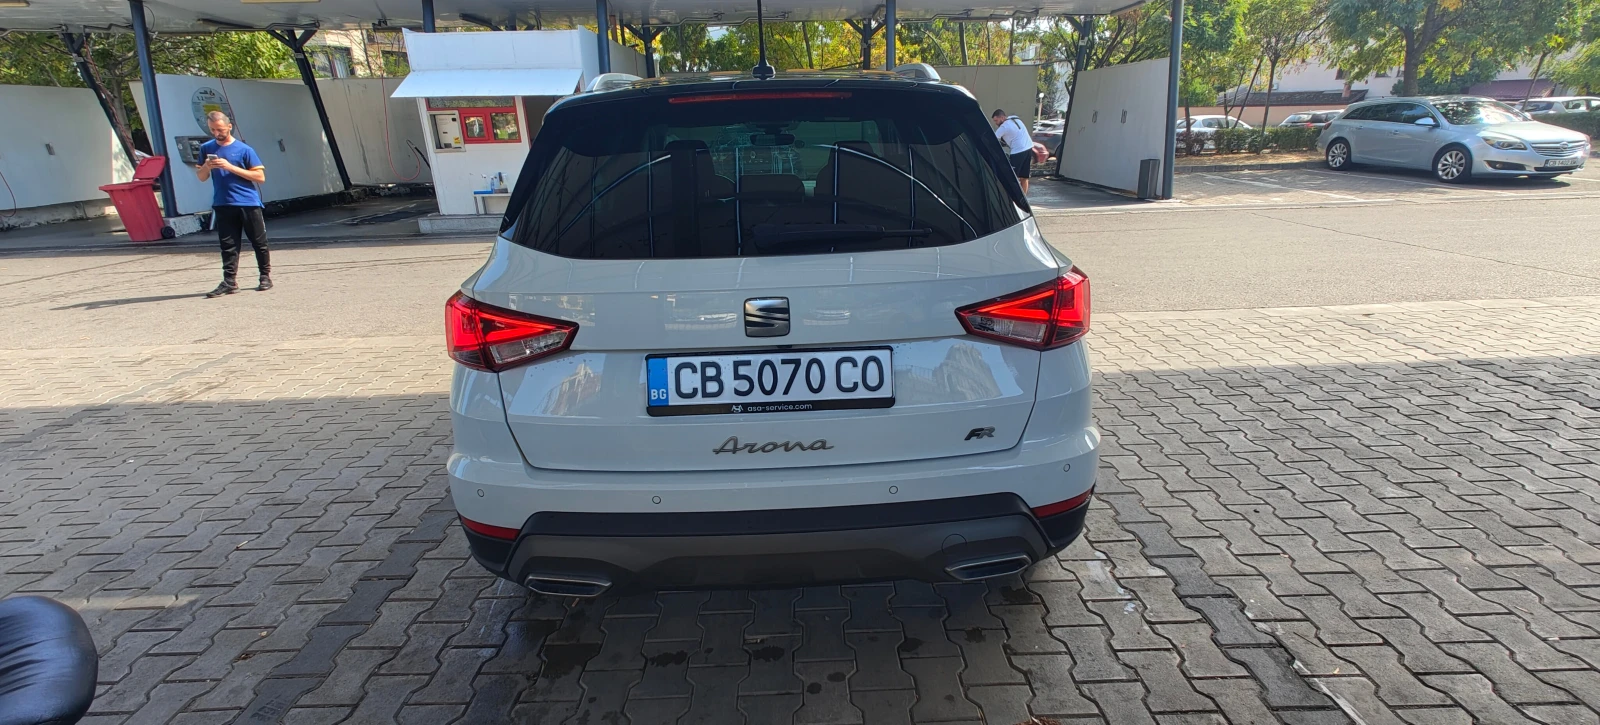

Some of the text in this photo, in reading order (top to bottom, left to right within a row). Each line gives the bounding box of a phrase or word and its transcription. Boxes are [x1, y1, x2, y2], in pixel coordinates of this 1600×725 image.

[674, 355, 885, 399] CB 5070 CO
[651, 388, 667, 400] BG
[747, 403, 813, 412] asa-service.com
[964, 426, 996, 441] FR
[712, 435, 834, 454] Arona
